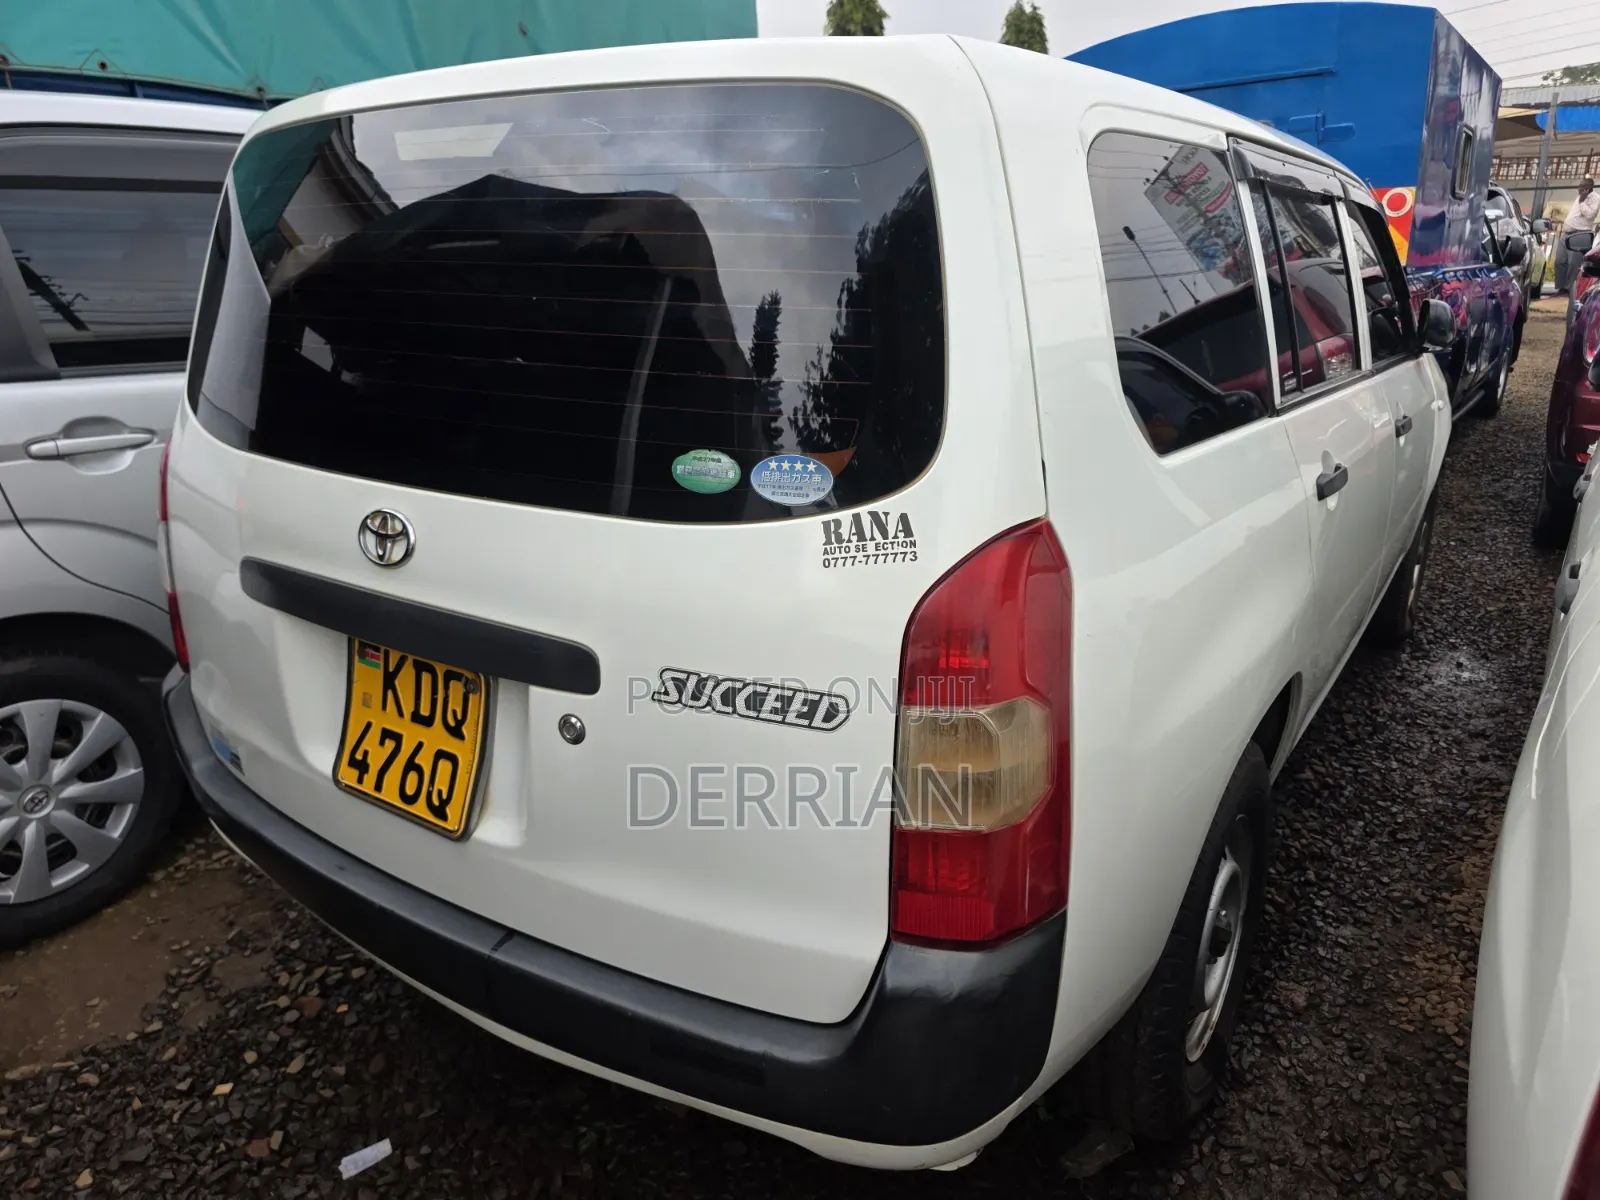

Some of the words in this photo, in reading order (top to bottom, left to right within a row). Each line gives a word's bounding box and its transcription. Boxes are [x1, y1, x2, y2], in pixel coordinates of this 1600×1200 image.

[761, 470, 823, 486] 低排出ガス車
[821, 510, 914, 546] RANA
[822, 545, 851, 556] AUTO
[822, 550, 918, 568] 0777-777773
[381, 649, 471, 741] KDQ
[653, 669, 849, 731] SUCCEED
[347, 720, 460, 822] 476Q
